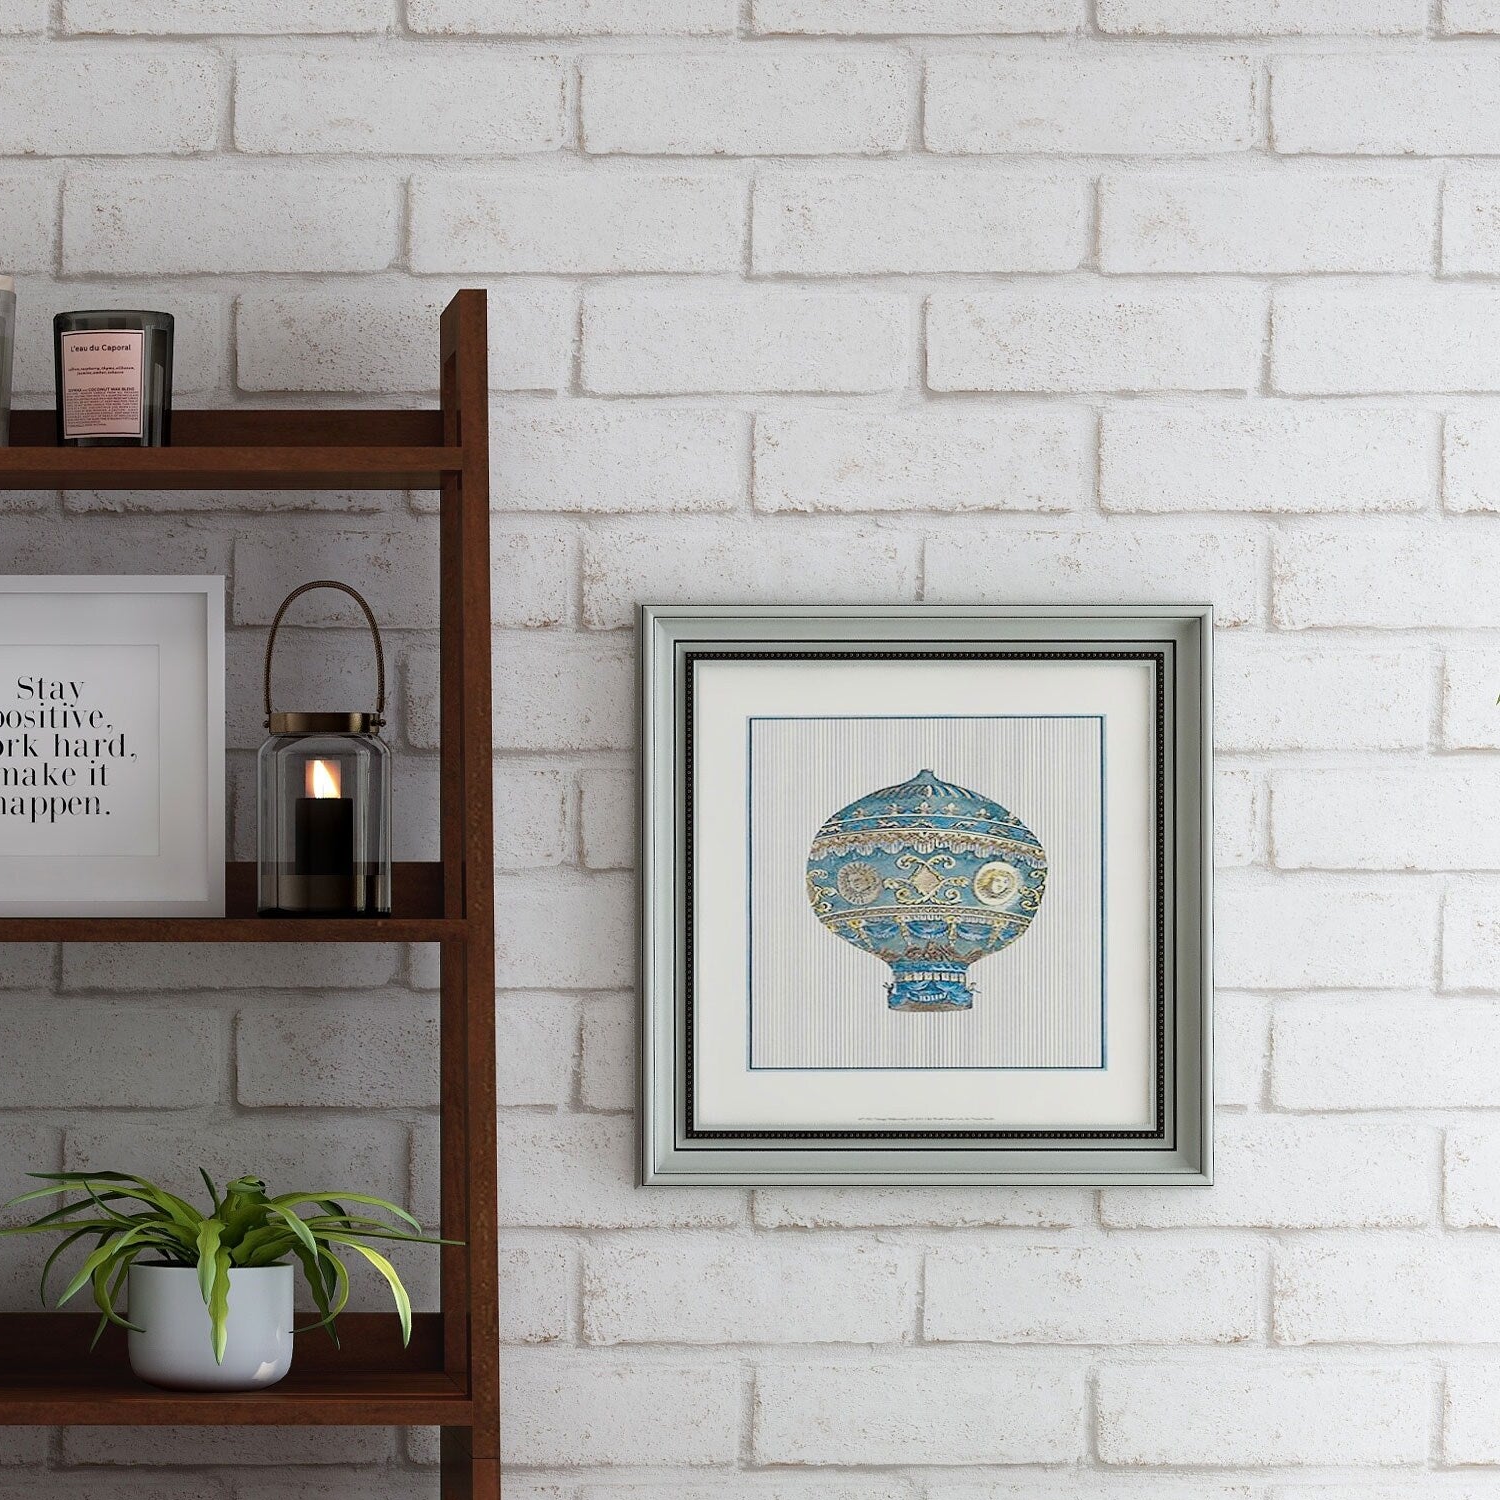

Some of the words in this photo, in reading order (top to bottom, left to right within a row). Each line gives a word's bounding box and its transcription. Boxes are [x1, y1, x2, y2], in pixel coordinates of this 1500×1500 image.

[101, 344, 131, 352] Caporal
[16, 675, 86, 706] Stay
[53, 733, 138, 763] hard,
[88, 760, 110, 787] it
